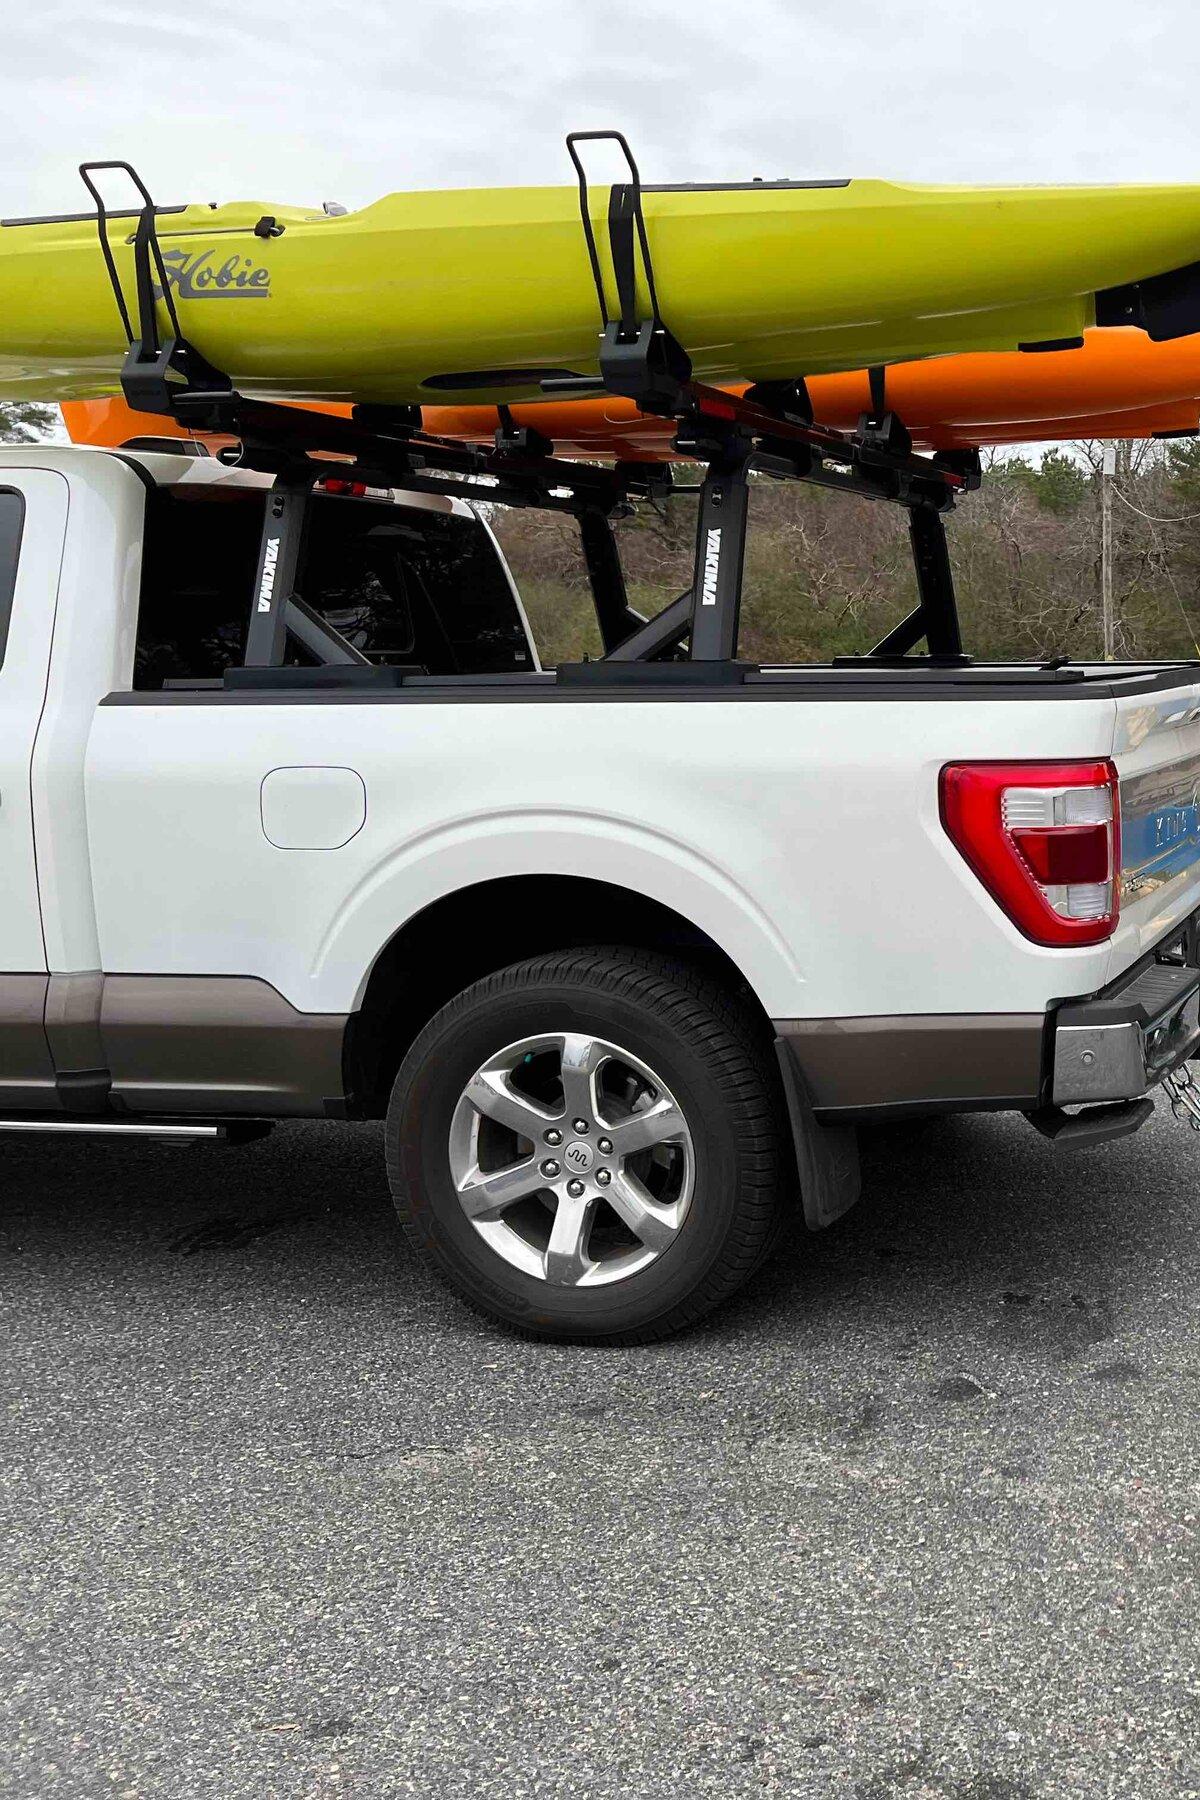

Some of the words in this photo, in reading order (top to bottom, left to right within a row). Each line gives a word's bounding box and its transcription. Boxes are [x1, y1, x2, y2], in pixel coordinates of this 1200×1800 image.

[154, 249, 271, 299] Hobie
[257, 539, 280, 612] YAKIMA
[702, 529, 721, 606] YAKIMA
